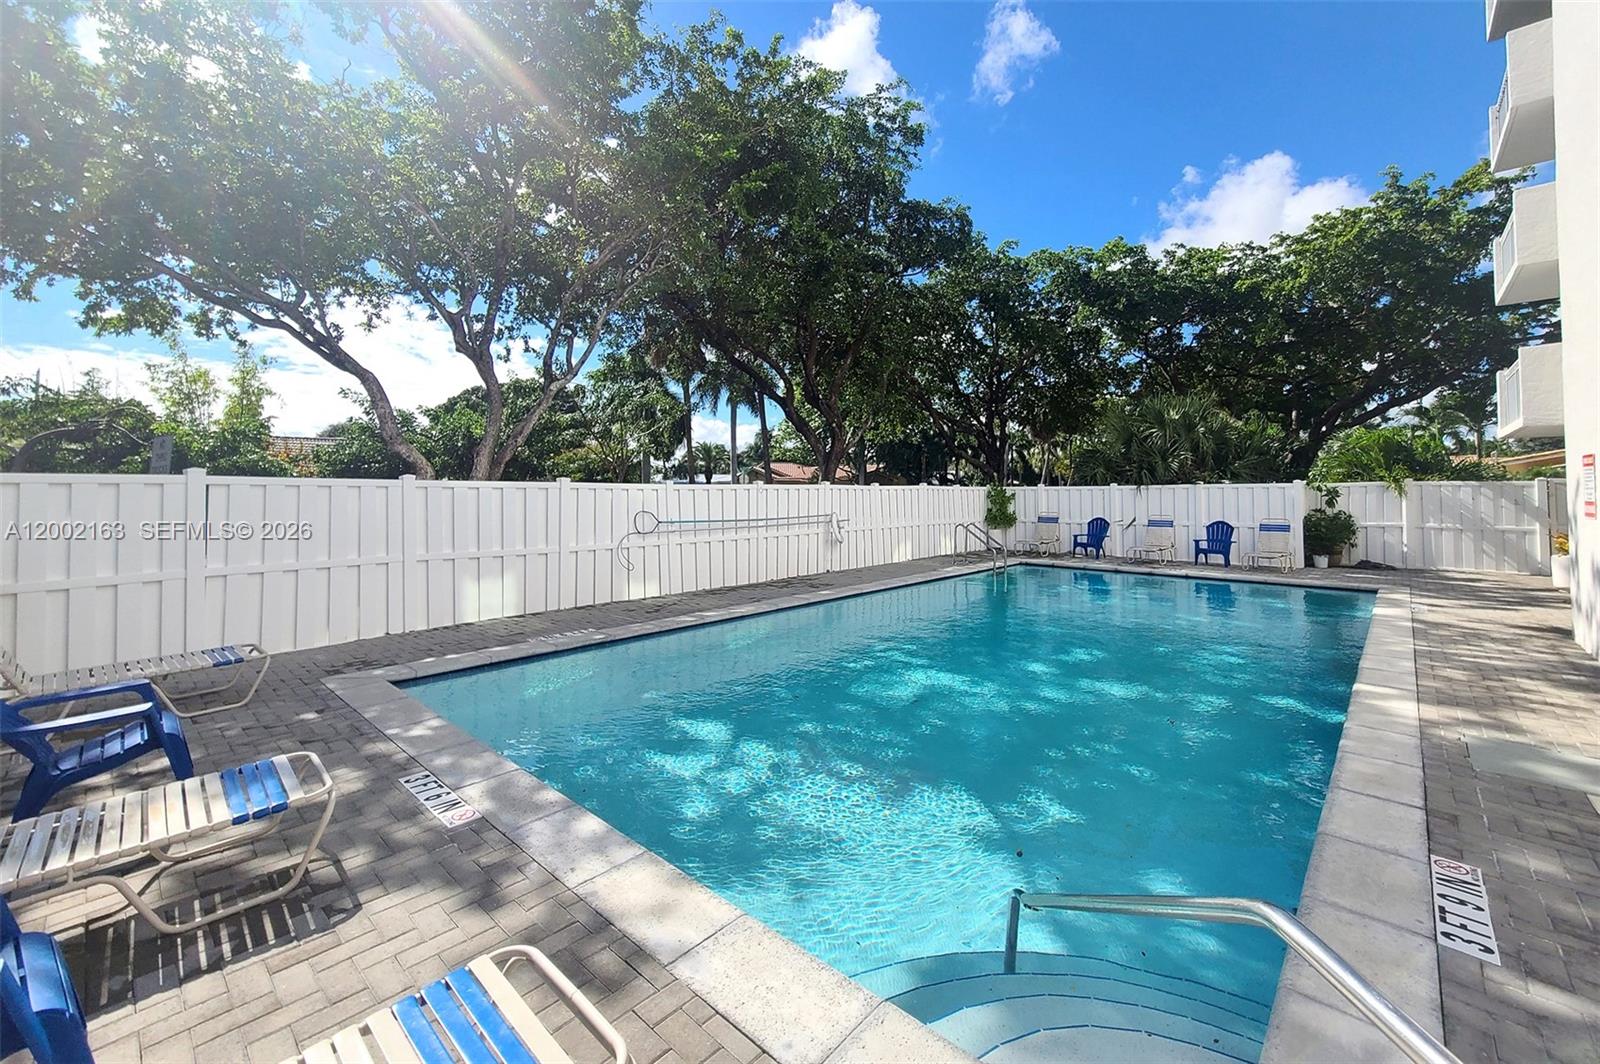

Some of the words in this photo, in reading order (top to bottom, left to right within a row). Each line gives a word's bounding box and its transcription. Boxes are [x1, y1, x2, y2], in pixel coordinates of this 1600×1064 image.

[1435, 871, 1483, 899] IN
[1438, 905, 1492, 939] FT
[1440, 931, 1495, 955] 3
